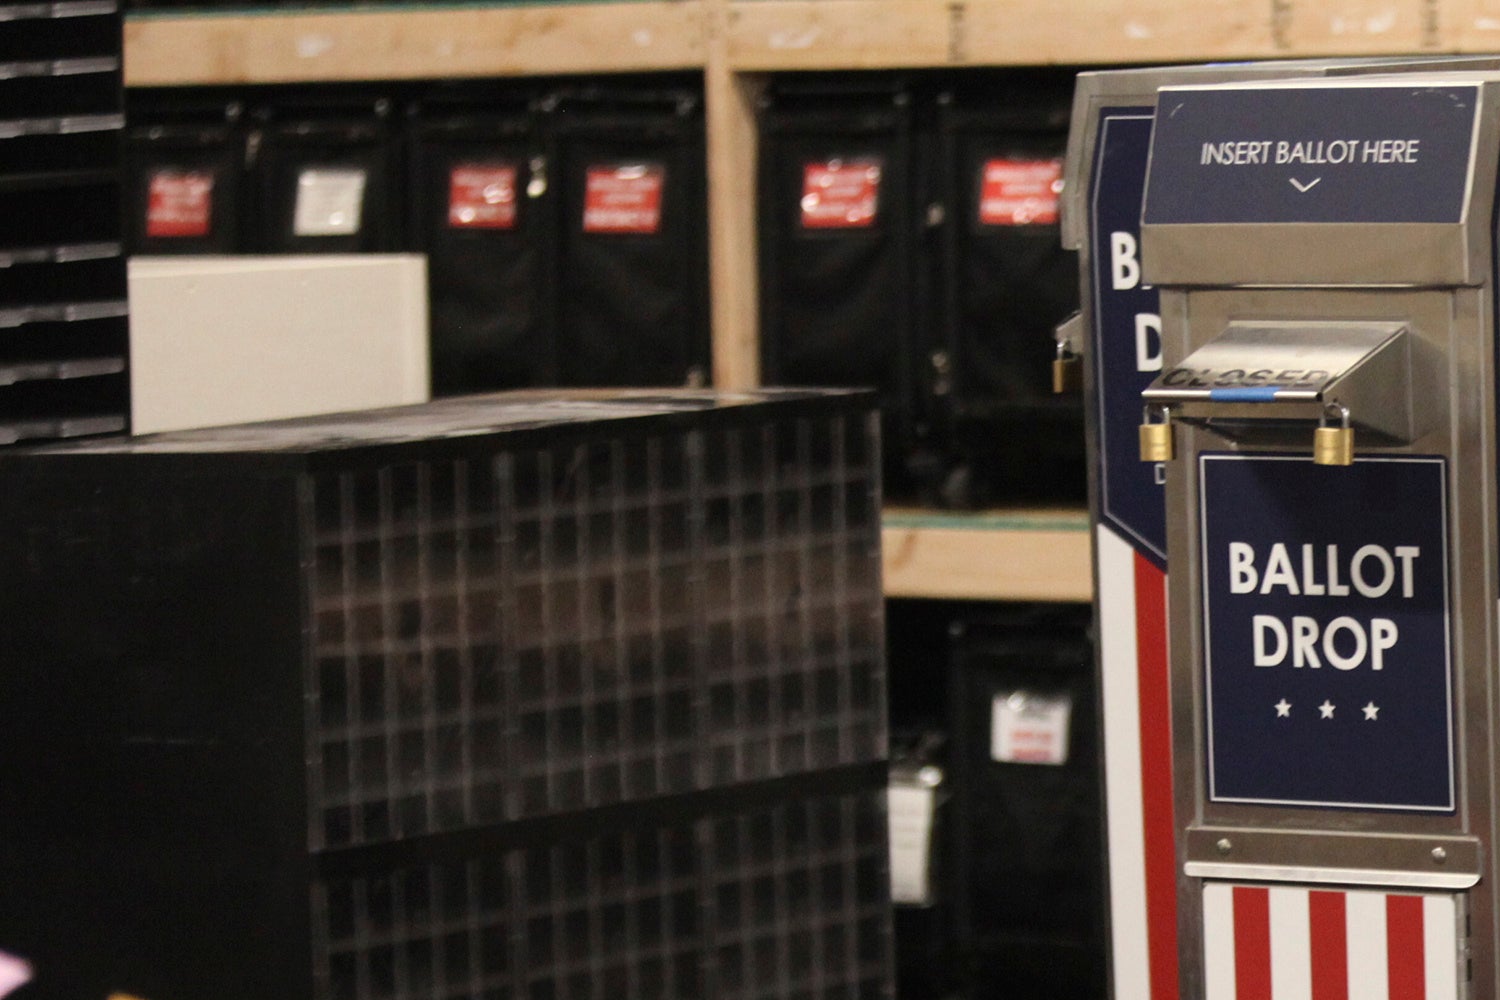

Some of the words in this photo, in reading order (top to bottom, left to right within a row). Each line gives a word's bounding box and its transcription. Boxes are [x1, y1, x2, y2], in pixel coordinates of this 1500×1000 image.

[1200, 140, 1273, 166] INSERT
[1275, 139, 1360, 165] BALLOT
[1361, 138, 1421, 164] HERE
[1229, 541, 1421, 598] BALLOT
[1252, 614, 1399, 671] DROP
